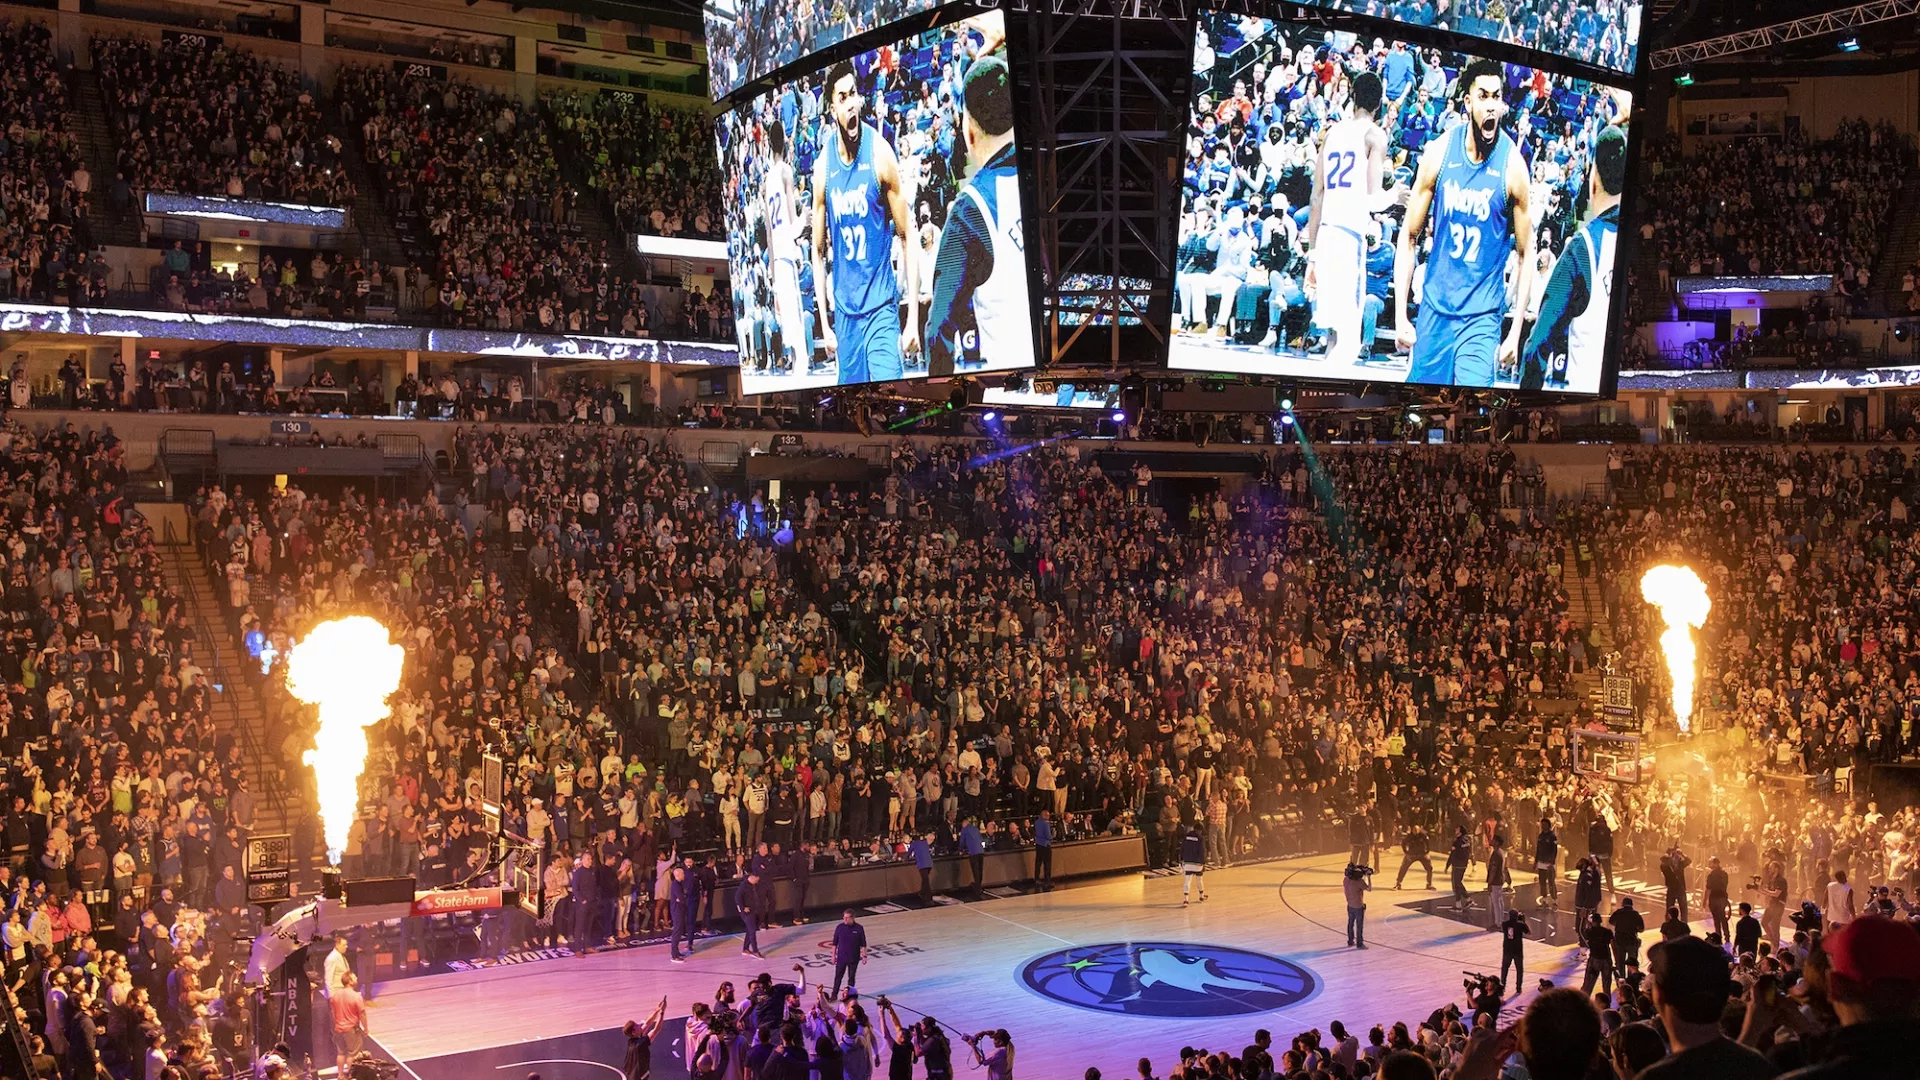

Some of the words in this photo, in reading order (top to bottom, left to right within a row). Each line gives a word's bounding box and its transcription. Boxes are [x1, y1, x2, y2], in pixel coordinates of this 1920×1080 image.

[180, 33, 206, 48] 230
[409, 64, 430, 77] 231
[613, 91, 634, 104] 232
[1327, 151, 1356, 189] 22
[768, 192, 782, 230] 22
[840, 225, 867, 261] 32
[1449, 220, 1482, 263] 32
[962, 329, 976, 349] G
[1554, 353, 1567, 371] G
[281, 422, 301, 432] 130
[781, 435, 797, 445] 132
[261, 871, 288, 880] TISSOT
[434, 896, 461, 908] State
[462, 894, 488, 906] Farm
[470, 946, 575, 969] AYOFFS
[790, 941, 905, 962] TAET
[804, 946, 925, 968] CTER
[288, 978, 297, 1011] NBA
[288, 1014, 297, 1036] TV
